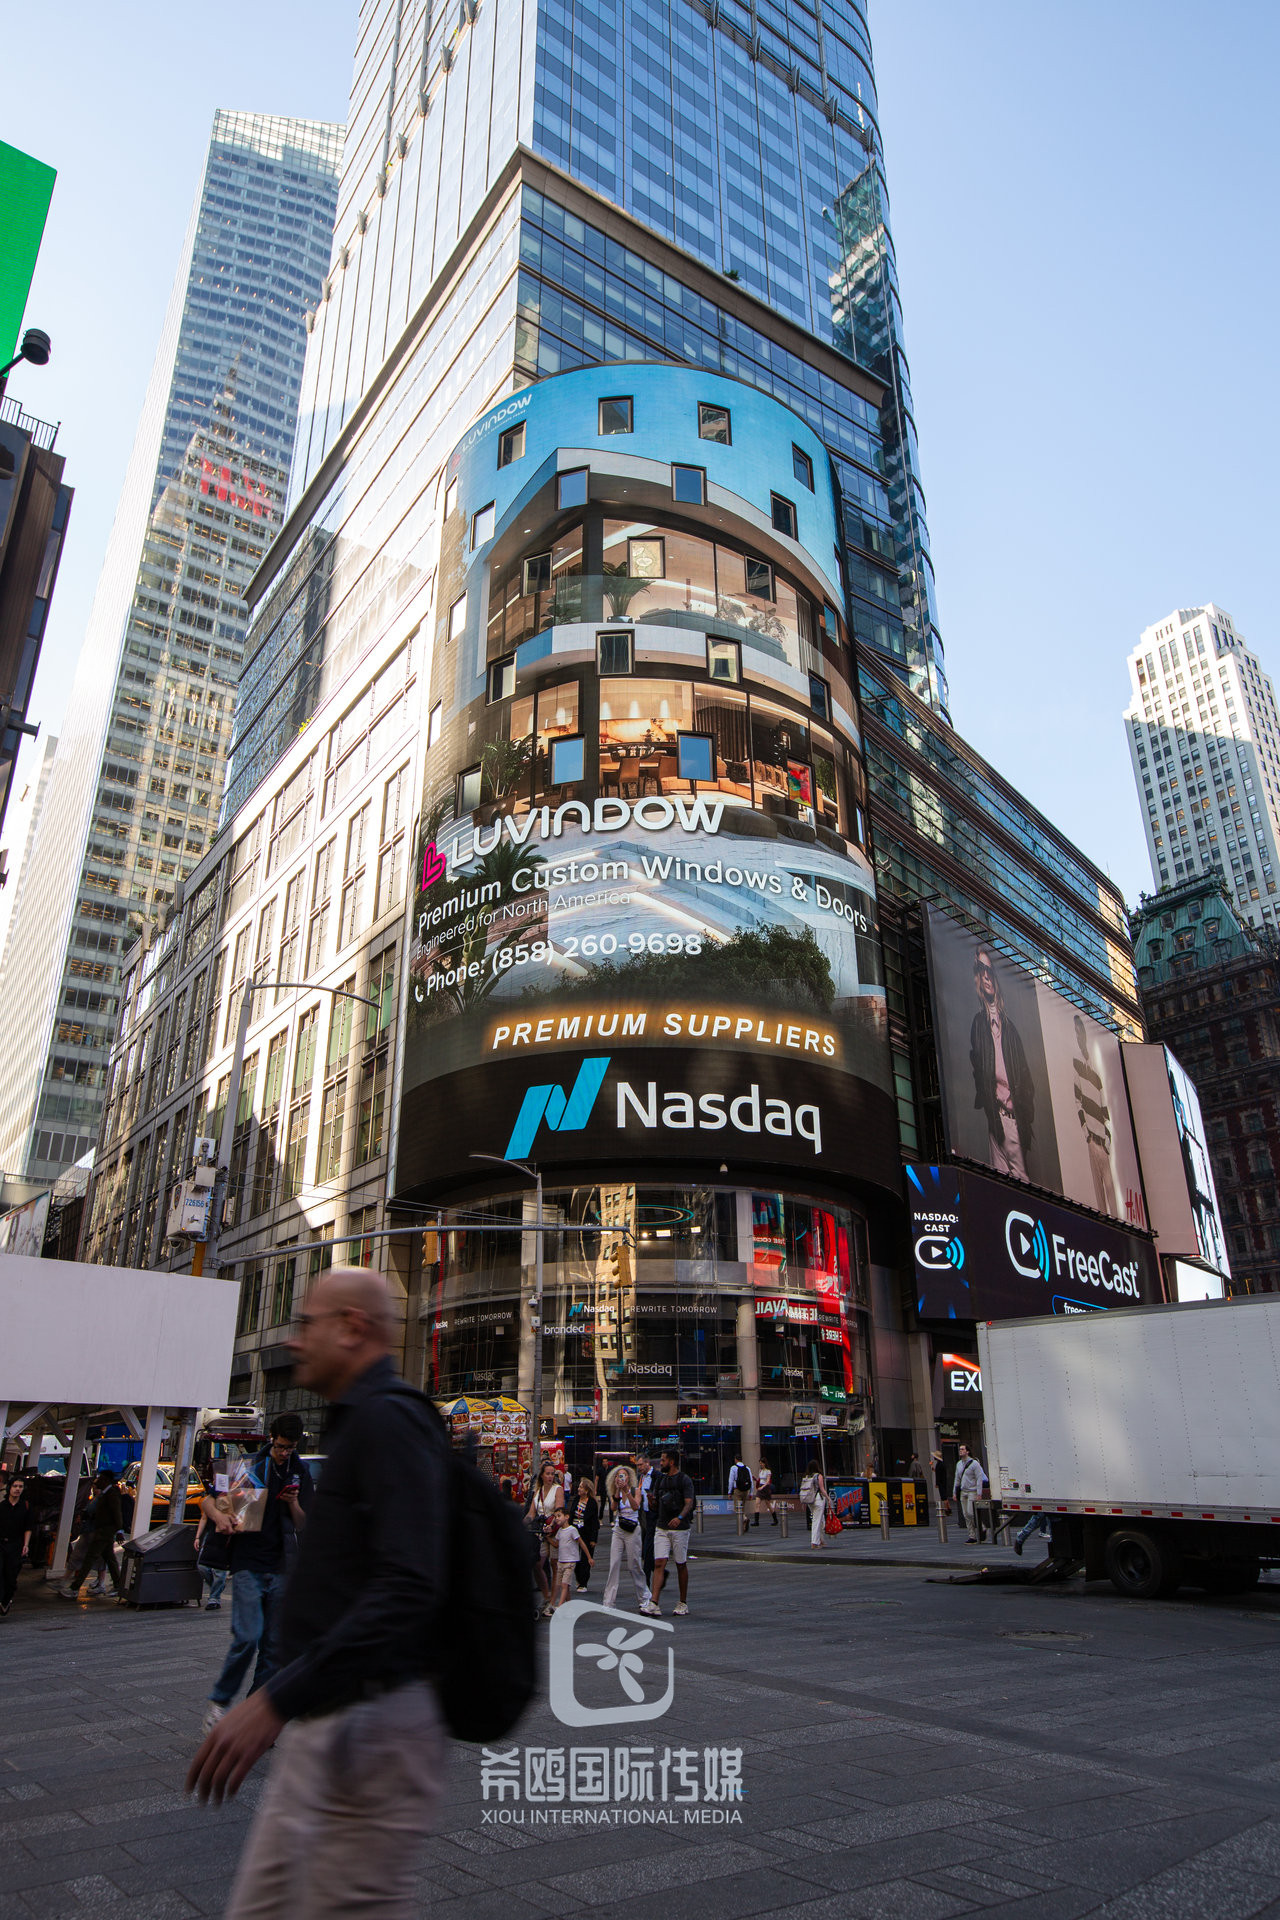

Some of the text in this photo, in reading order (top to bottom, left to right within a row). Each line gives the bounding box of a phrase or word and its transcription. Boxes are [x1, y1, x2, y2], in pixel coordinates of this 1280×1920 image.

[451, 797, 724, 870] LUVINDOW
[416, 890, 632, 960] Engineered for North America
[418, 855, 867, 937] Premium Custom Windows & Doors
[426, 931, 702, 997] Phone: (858) 260-9698
[493, 1013, 836, 1056] PREMIUM SUPPLIERS
[616, 1081, 823, 1155] Nasdaq
[913, 1212, 959, 1223] NASDAQ:
[924, 1224, 950, 1232] CAST
[1052, 1233, 1140, 1299] FreeCast
[583, 1305, 718, 1315] Nasdaq REWRITE TOMORROW
[628, 1363, 672, 1377] Nasdaq
